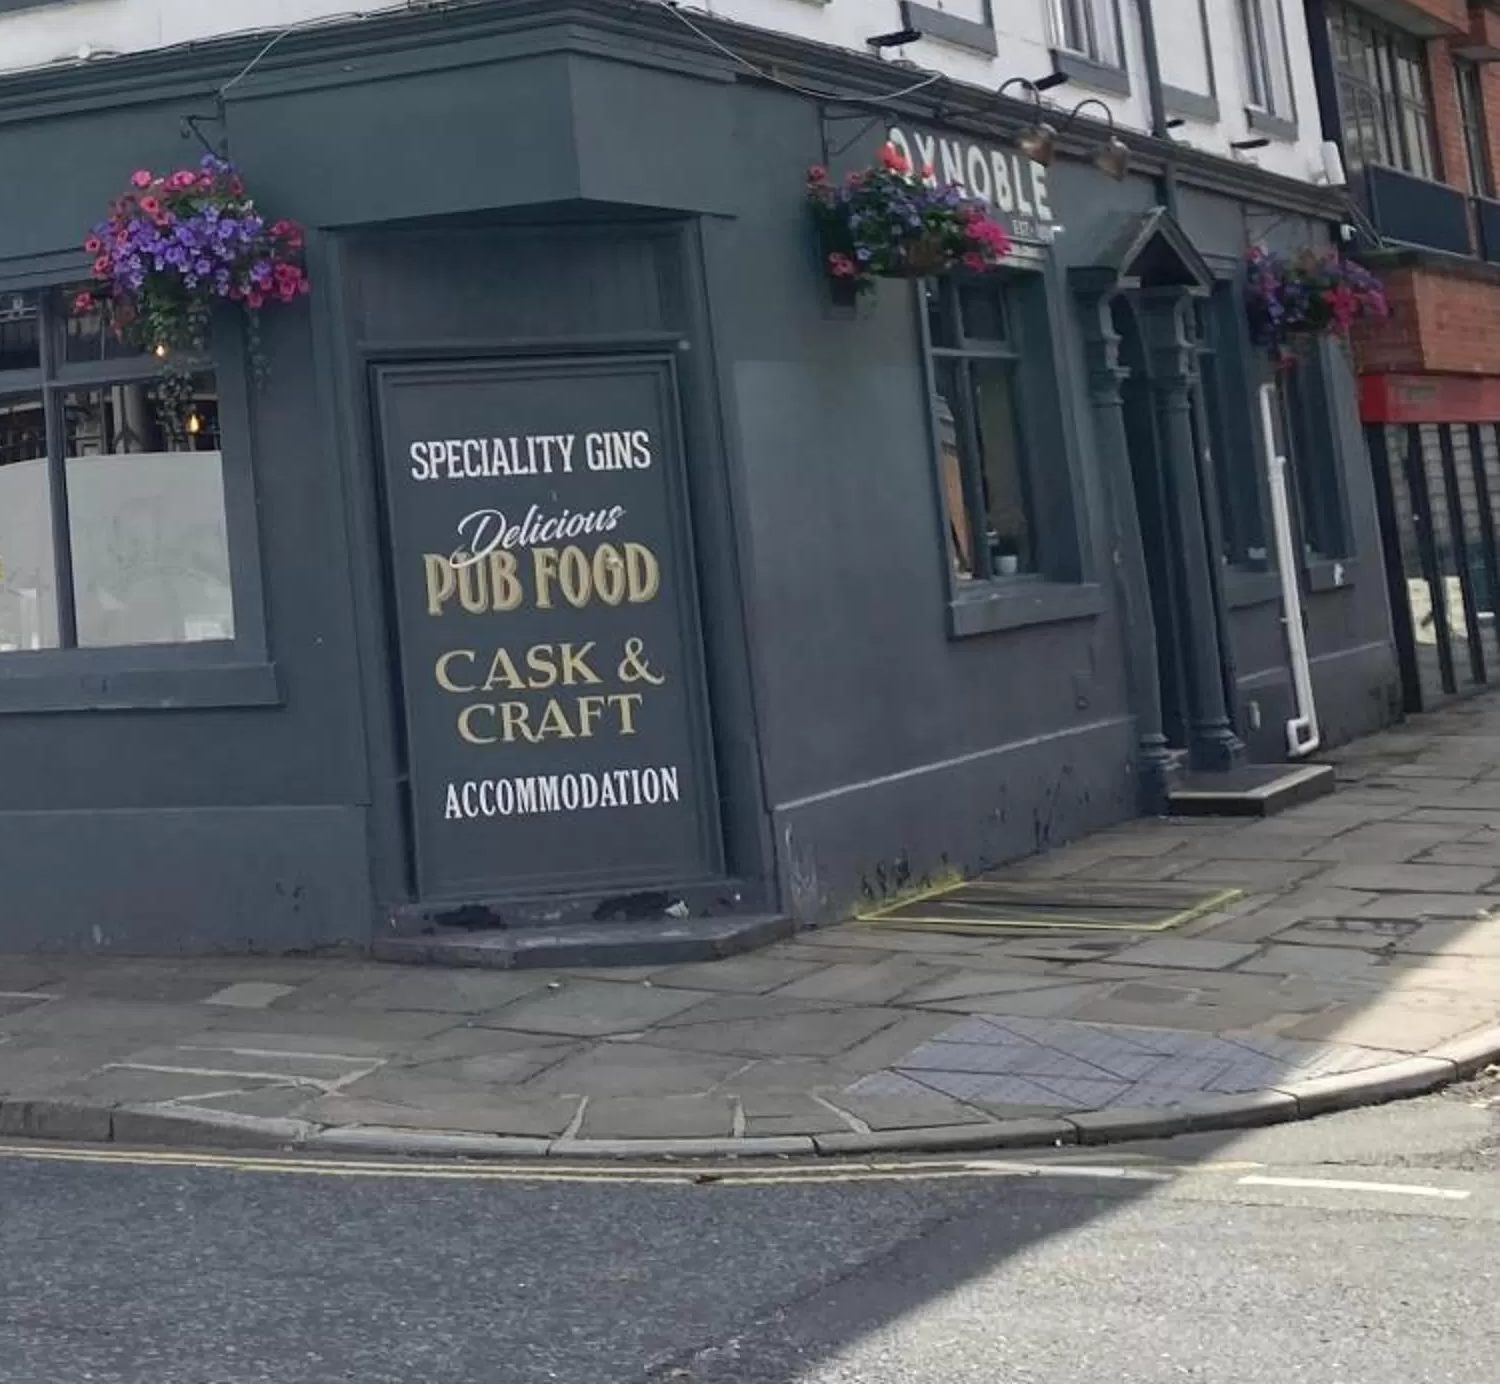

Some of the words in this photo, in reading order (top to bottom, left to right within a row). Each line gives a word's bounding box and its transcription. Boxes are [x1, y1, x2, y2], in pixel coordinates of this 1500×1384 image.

[410, 434, 575, 481] SPECIALITY
[585, 430, 651, 471] GINS
[450, 504, 626, 569] Delicious
[423, 548, 524, 616] PUB
[531, 542, 660, 609] FOOD
[435, 640, 603, 693] CASK
[617, 637, 665, 686] &
[457, 693, 643, 744] CRAFT
[444, 766, 680, 819] ACCOMMODATION
